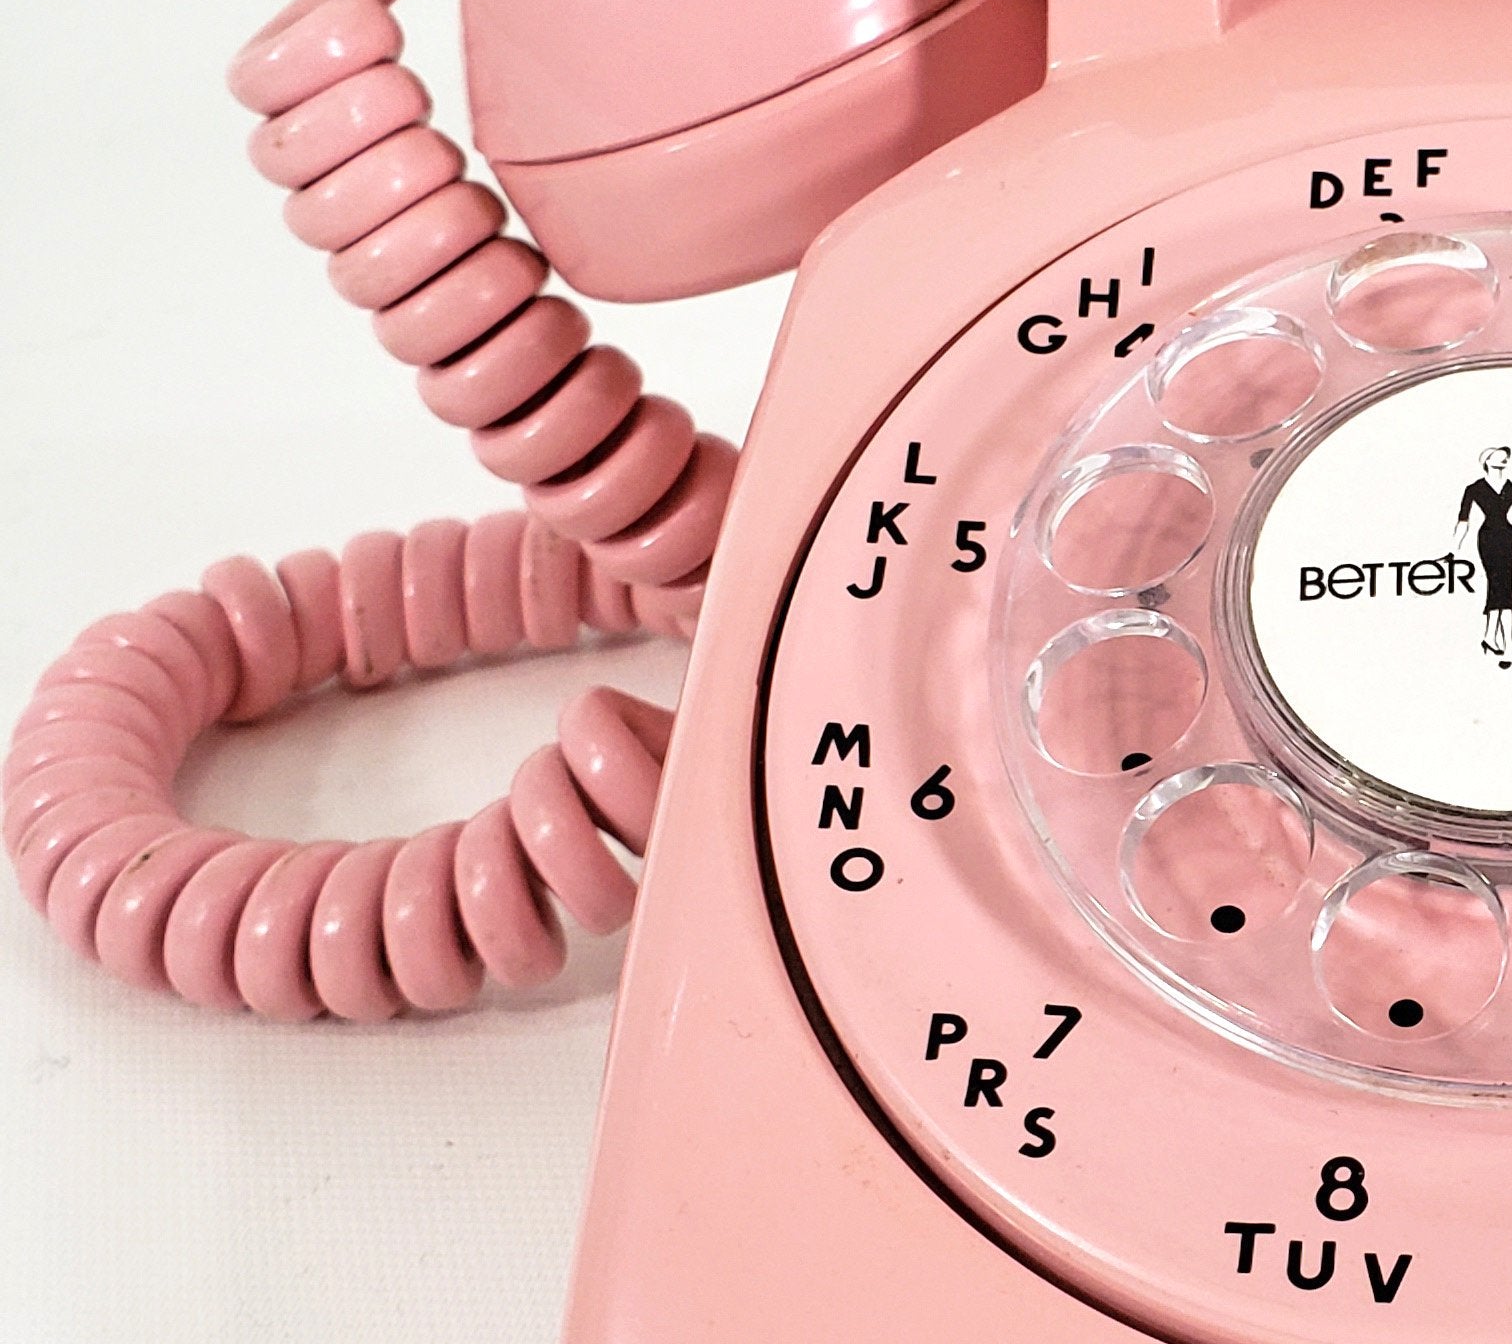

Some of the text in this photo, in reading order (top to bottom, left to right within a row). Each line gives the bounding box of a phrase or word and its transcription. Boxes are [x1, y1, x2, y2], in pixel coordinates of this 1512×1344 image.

[1310, 148, 1448, 209] DEF
[1017, 247, 1155, 355] GHI
[951, 520, 987, 573] 5
[811, 722, 885, 892] MNO
[910, 764, 955, 821] 6
[1032, 1003, 1082, 1059] 7
[925, 1013, 1056, 1159] PRS
[1315, 1156, 1369, 1222] 8
[1224, 1222, 1413, 1304] TUV
